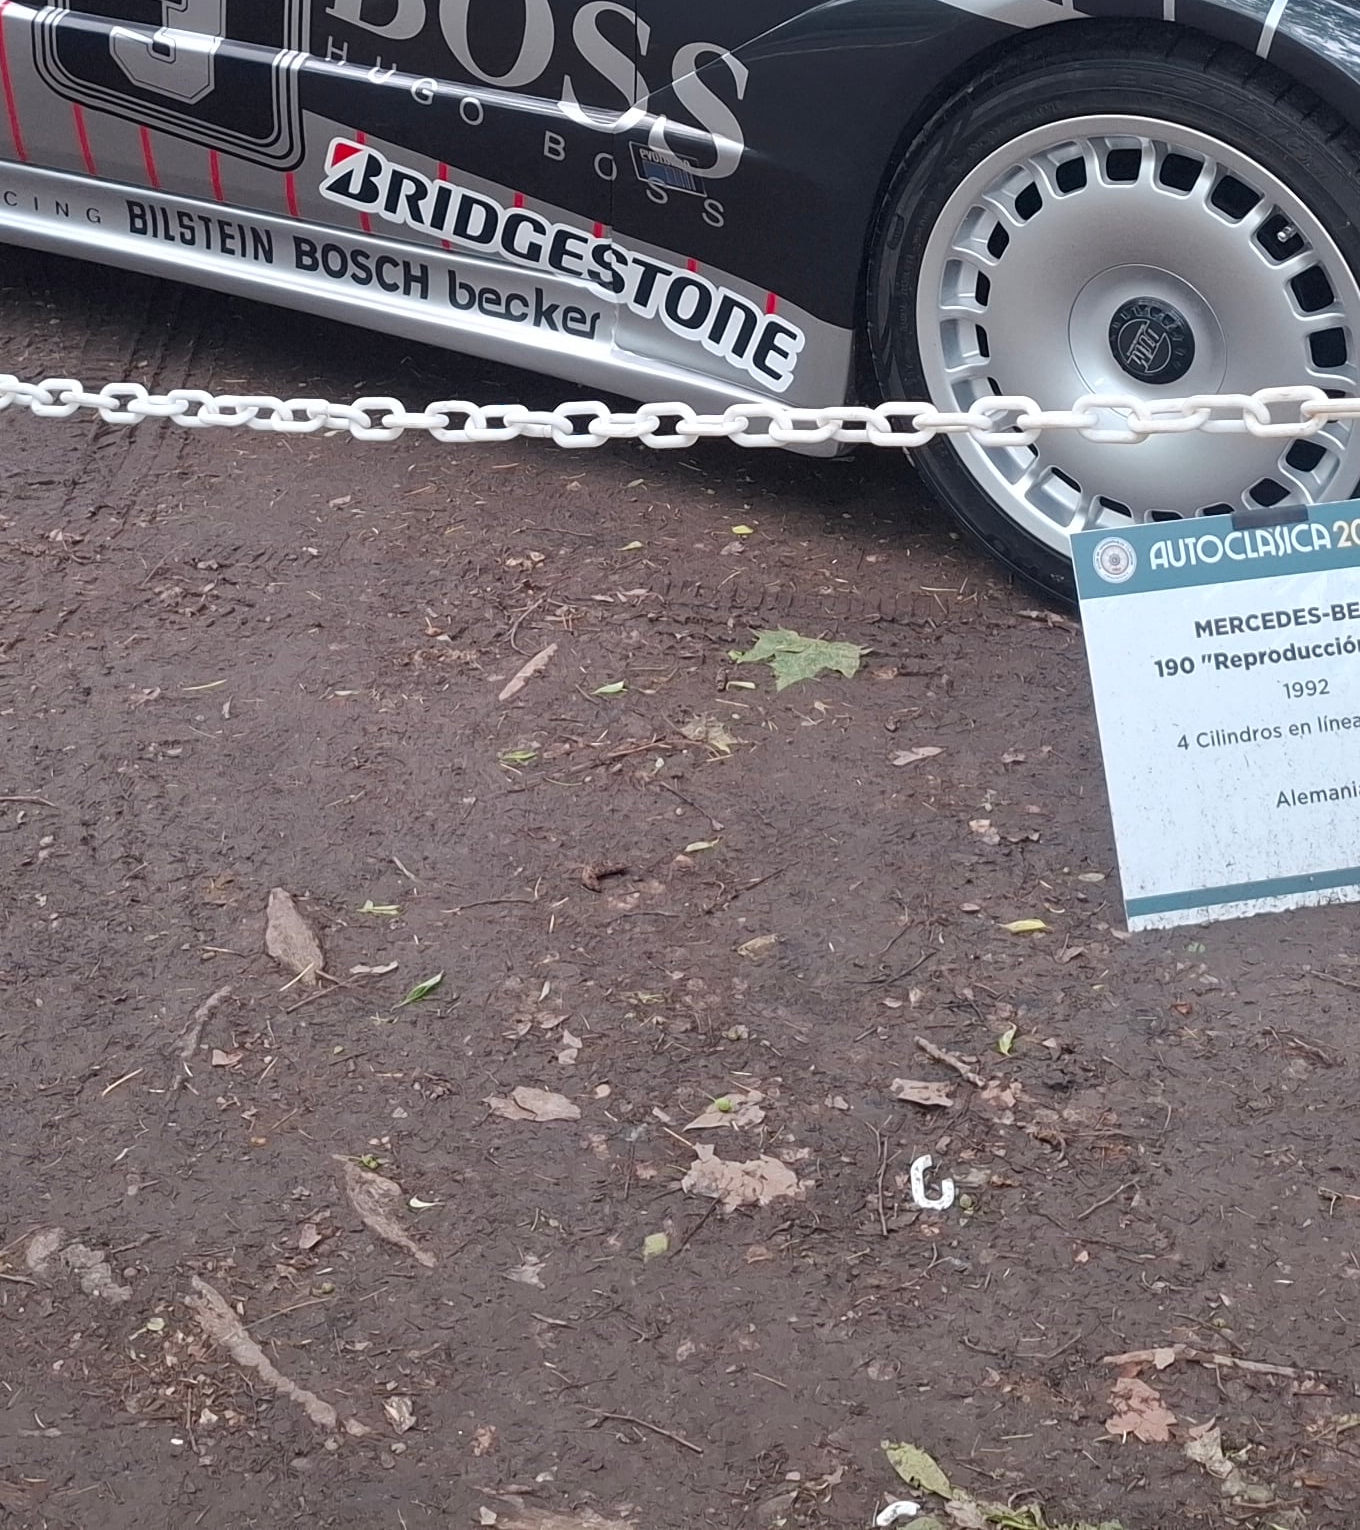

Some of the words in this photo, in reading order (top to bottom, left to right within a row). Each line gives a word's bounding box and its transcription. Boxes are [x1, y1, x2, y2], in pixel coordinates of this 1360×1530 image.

[326, 35, 485, 127] HUGO
[544, 130, 725, 227] BOSS
[129, 199, 274, 265] BILSTEIN
[294, 236, 430, 300] BOSCH
[448, 269, 600, 338] becker
[323, 140, 802, 388] BRIDGESTONE
[1154, 658, 1195, 677] 190
[1284, 679, 1330, 700] 1992
[1177, 734, 1190, 751] 4
[1197, 719, 1282, 749] Cilindros
[1289, 721, 1312, 735] en
